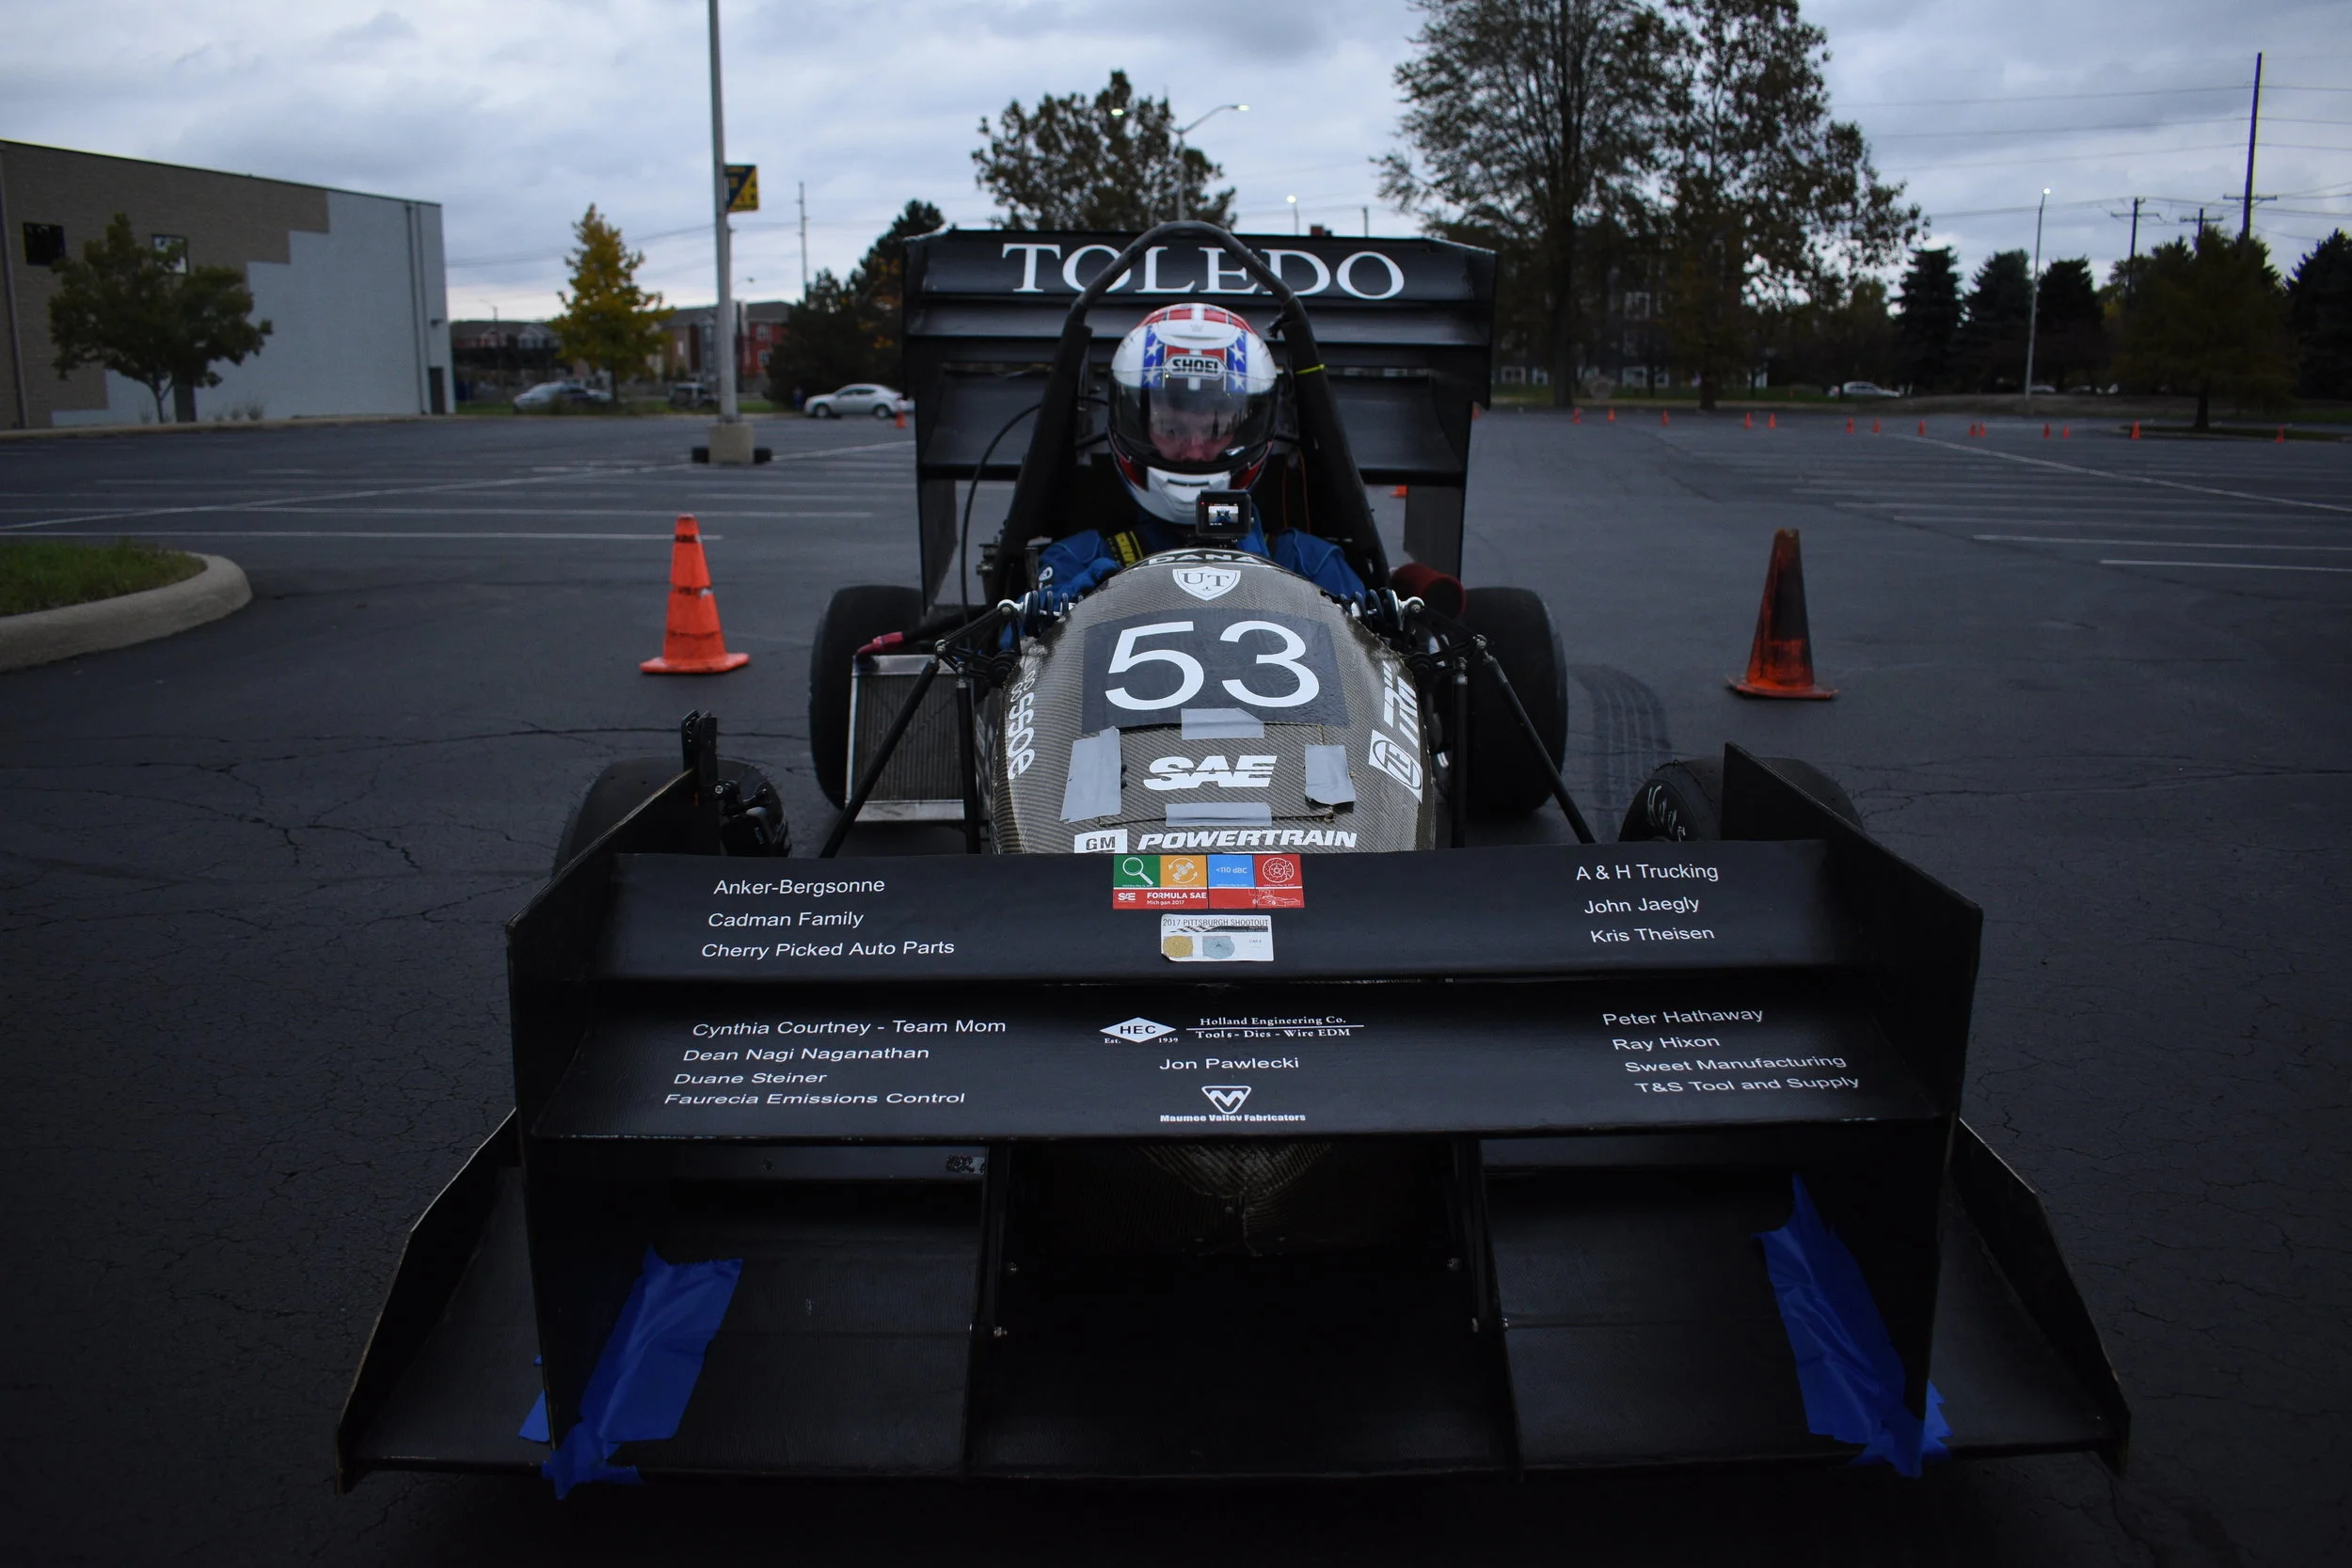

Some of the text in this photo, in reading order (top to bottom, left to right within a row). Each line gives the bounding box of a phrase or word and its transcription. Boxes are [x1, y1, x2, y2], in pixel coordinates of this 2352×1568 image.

[1002, 243, 1404, 299] TOLEDO
[1172, 358, 1218, 372] SHOEI
[1149, 554, 1262, 564] DANA
[1183, 573, 1230, 586] UT
[1104, 620, 1320, 710] 53
[1144, 755, 1278, 791] SAE
[1086, 831, 1357, 850] GM POWERTRAIN
[1577, 864, 1718, 881] A & H Trucking
[714, 879, 884, 896] Anker-Bergsonne
[1584, 896, 1698, 913] John Jaegly
[708, 911, 864, 928] Cadman Family
[1591, 927, 1714, 942] Kris Theisen
[702, 942, 954, 959] Cherry Picked Auto Parts
[1251, 1017, 1322, 1025] Engineering
[1603, 1010, 1762, 1025] Peter Hathaway
[693, 1022, 769, 1037] Cynthia
[778, 1022, 870, 1036] Courtney
[893, 1021, 947, 1032] Team
[956, 1021, 1005, 1032] Mom
[1120, 1025, 1156, 1035] HEC
[1613, 1037, 1720, 1052] Ray Hixon
[684, 1048, 929, 1062] Dean Nagi Naganathan
[1160, 1057, 1298, 1069] Jon Pawlecki
[1626, 1056, 1846, 1071] Sweet Manufacturing
[675, 1073, 827, 1084] Duane Steiner
[1635, 1077, 1858, 1092] T&S Tool and Supply
[665, 1093, 964, 1103] Faurecia Emissions Control
